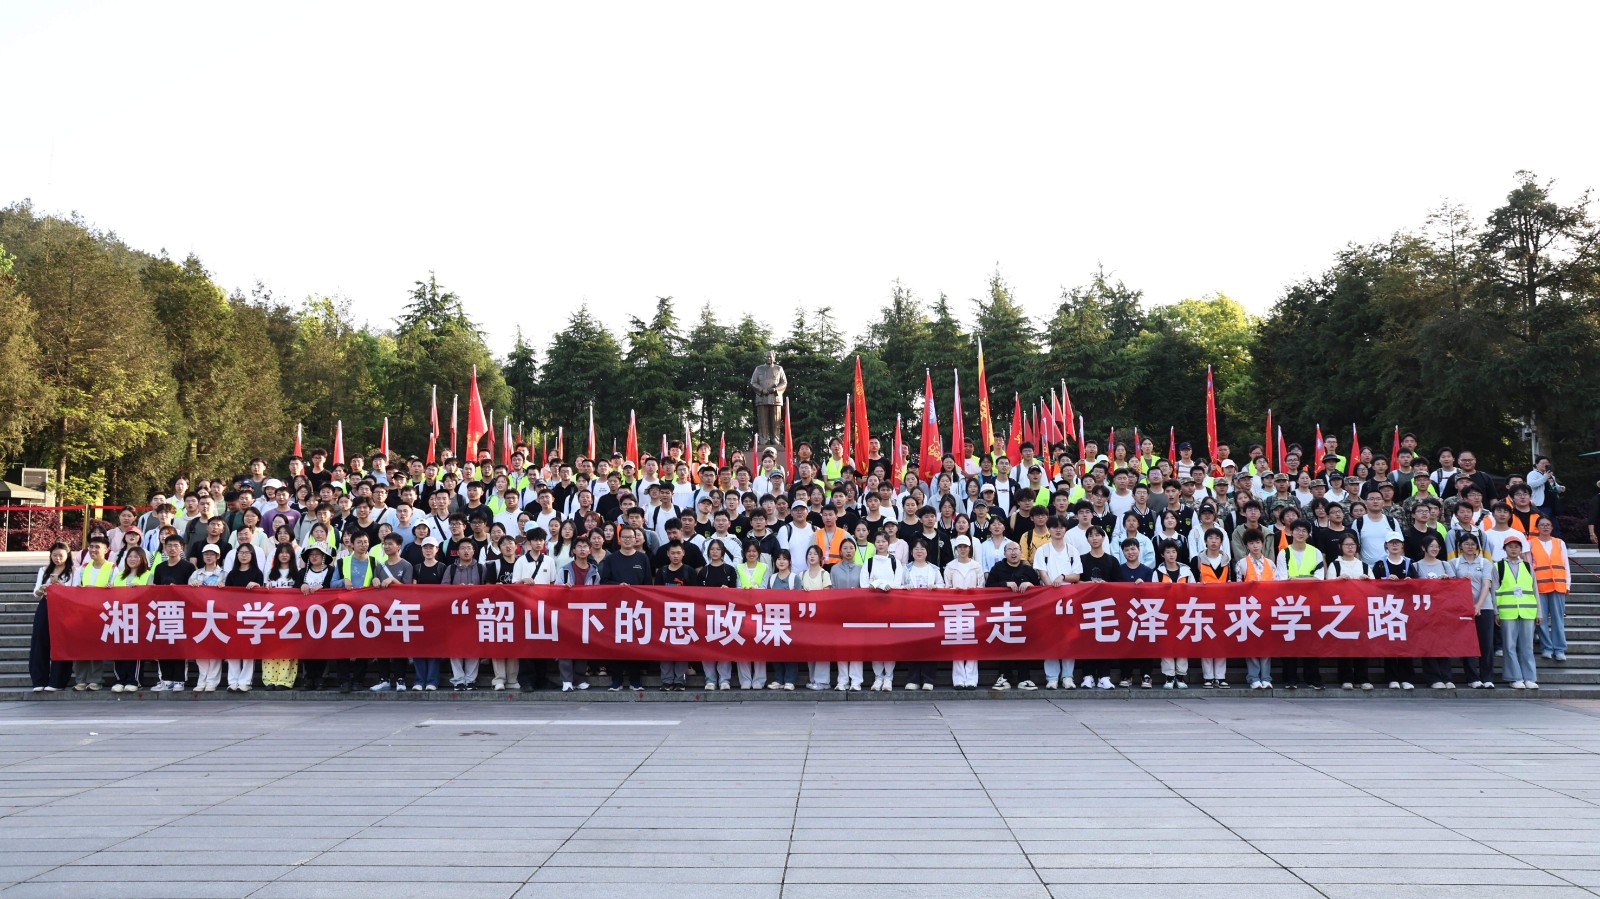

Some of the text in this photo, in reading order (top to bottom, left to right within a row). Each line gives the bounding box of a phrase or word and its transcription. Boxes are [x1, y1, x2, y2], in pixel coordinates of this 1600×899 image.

[100, 595, 1473, 646] 湘潭大学2026年“韶山下的思政课”——重走“毛泽东求学之路”
